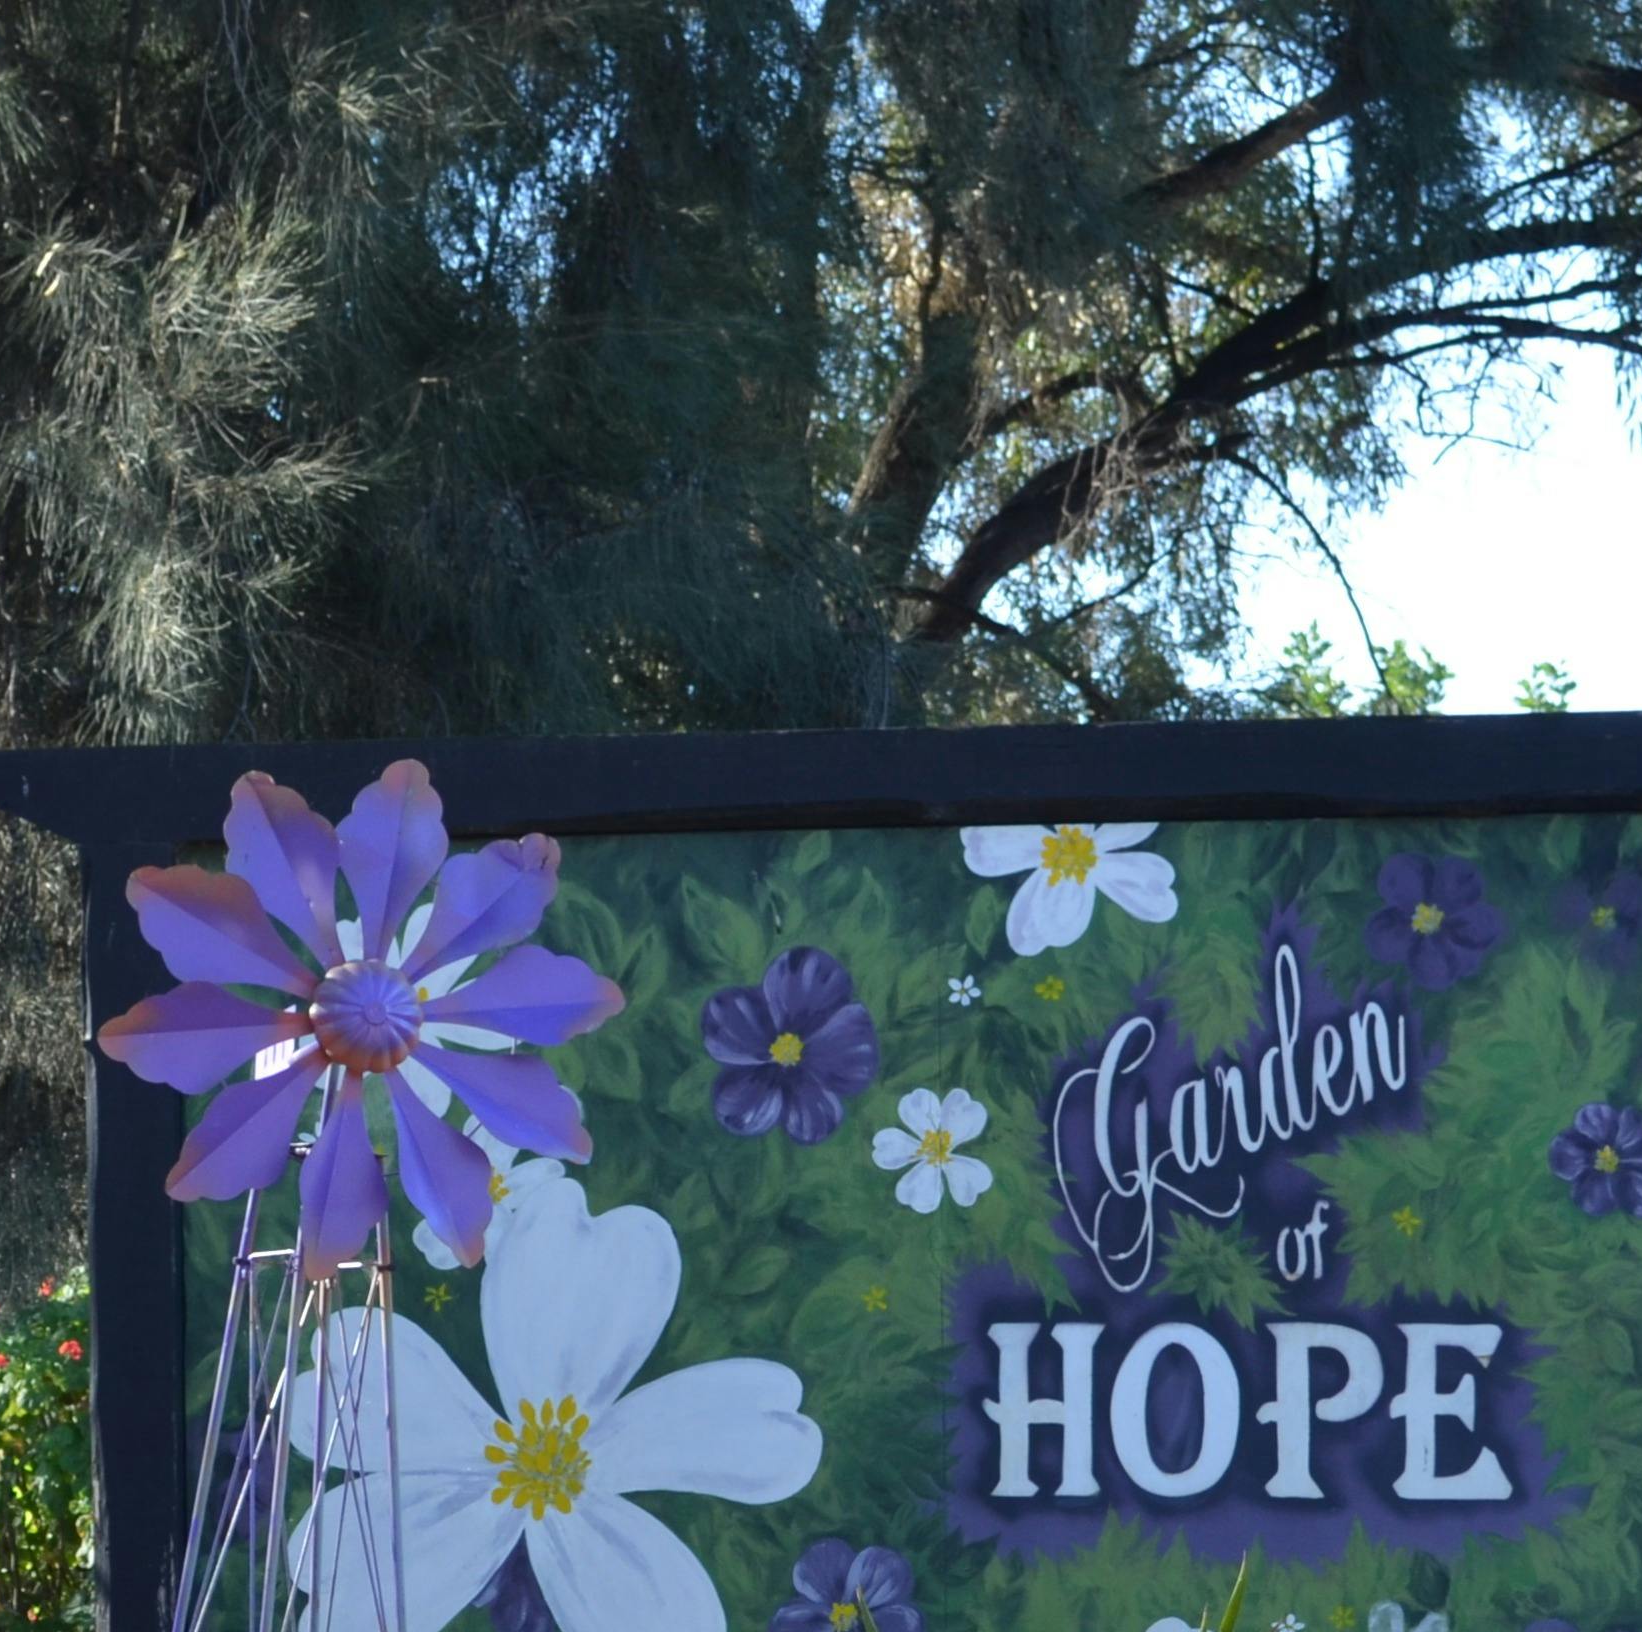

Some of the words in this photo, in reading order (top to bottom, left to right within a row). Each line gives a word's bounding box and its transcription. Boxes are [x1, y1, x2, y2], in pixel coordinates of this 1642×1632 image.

[1053, 944, 1407, 1293] Garden
[1275, 1200, 1330, 1281] of
[982, 1321, 1514, 1500] HOPE
